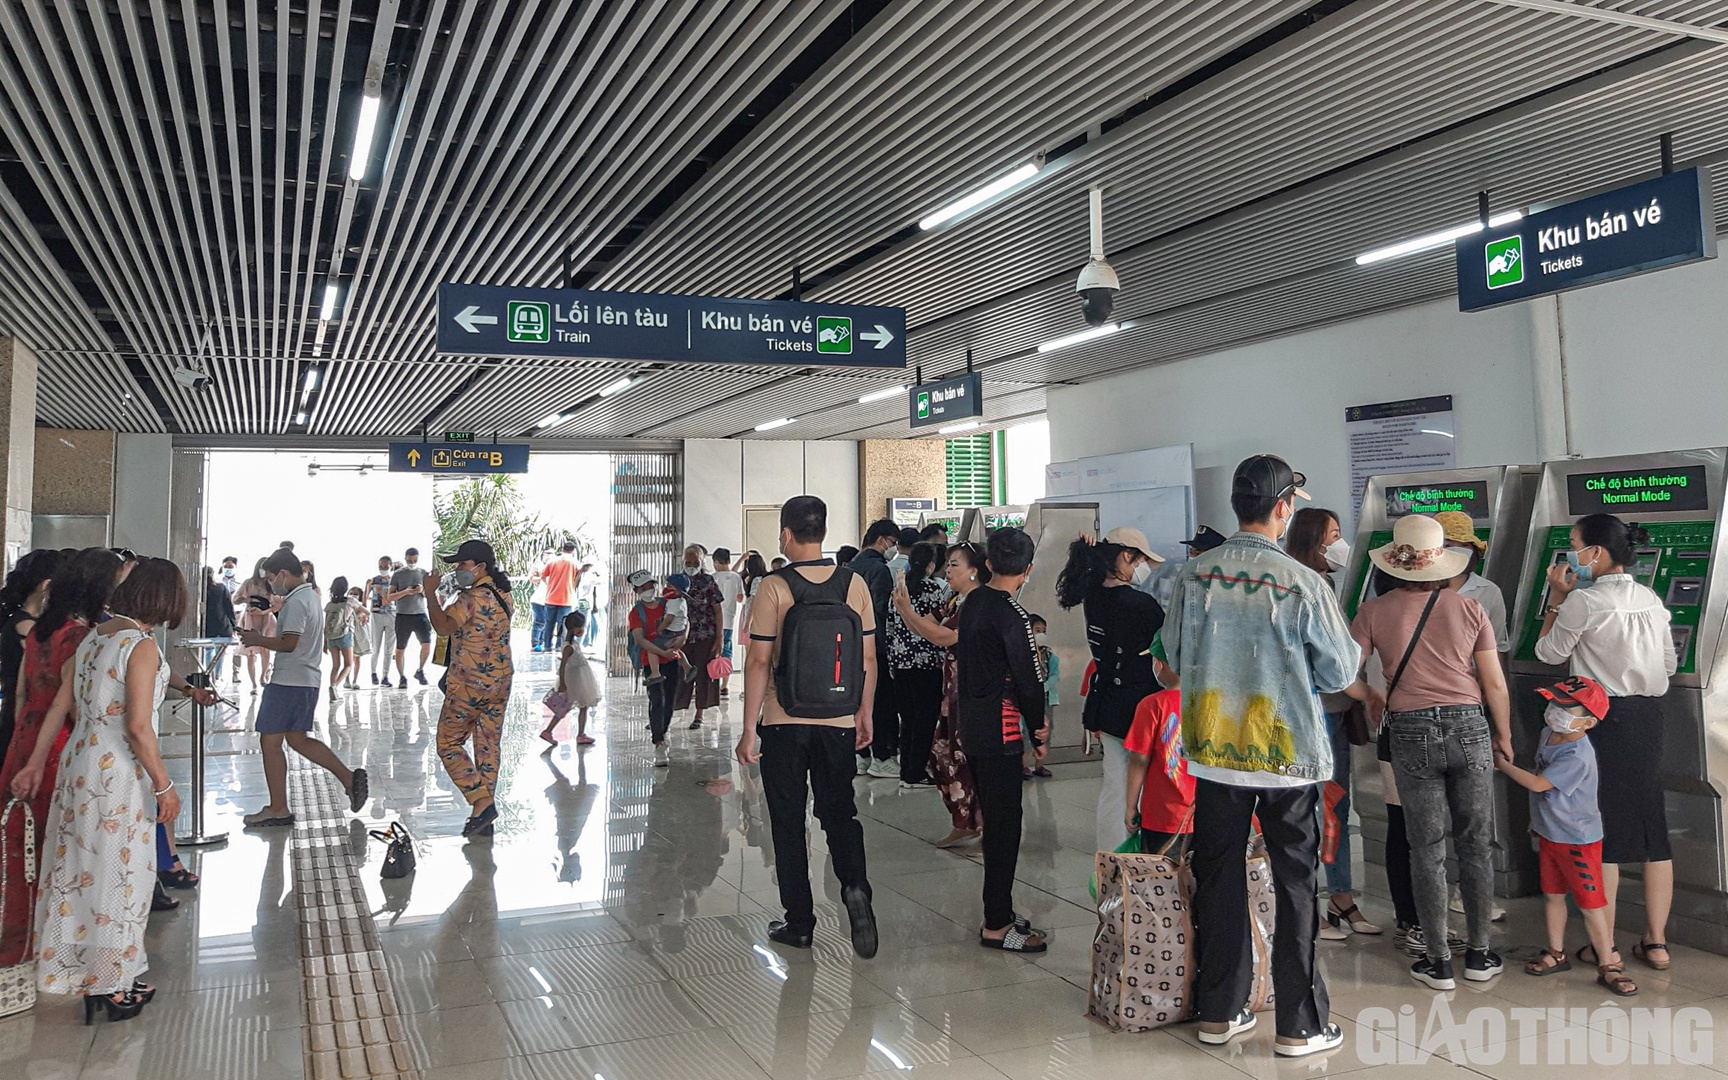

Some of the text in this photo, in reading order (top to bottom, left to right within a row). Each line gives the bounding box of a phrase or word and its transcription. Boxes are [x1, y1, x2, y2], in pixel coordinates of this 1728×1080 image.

[1538, 198, 1662, 253] Khu bán vé
[1540, 255, 1583, 275] Tickets
[554, 301, 668, 328] Lối lên tàu
[702, 311, 813, 335] Khu bán vé
[555, 329, 591, 344] Train
[766, 338, 813, 352] Tickets
[931, 390, 944, 403] Khu
[453, 449, 488, 459] Cửa ra
[489, 451, 503, 467] B
[1586, 475, 1687, 490] Chế độ bình thường
[1603, 490, 1671, 504] Normal Mode
[1411, 502, 1462, 513] Normal Mode
[1024, 620, 1036, 651] ARSENAL
[1032, 653, 1043, 683] ARSENAL
